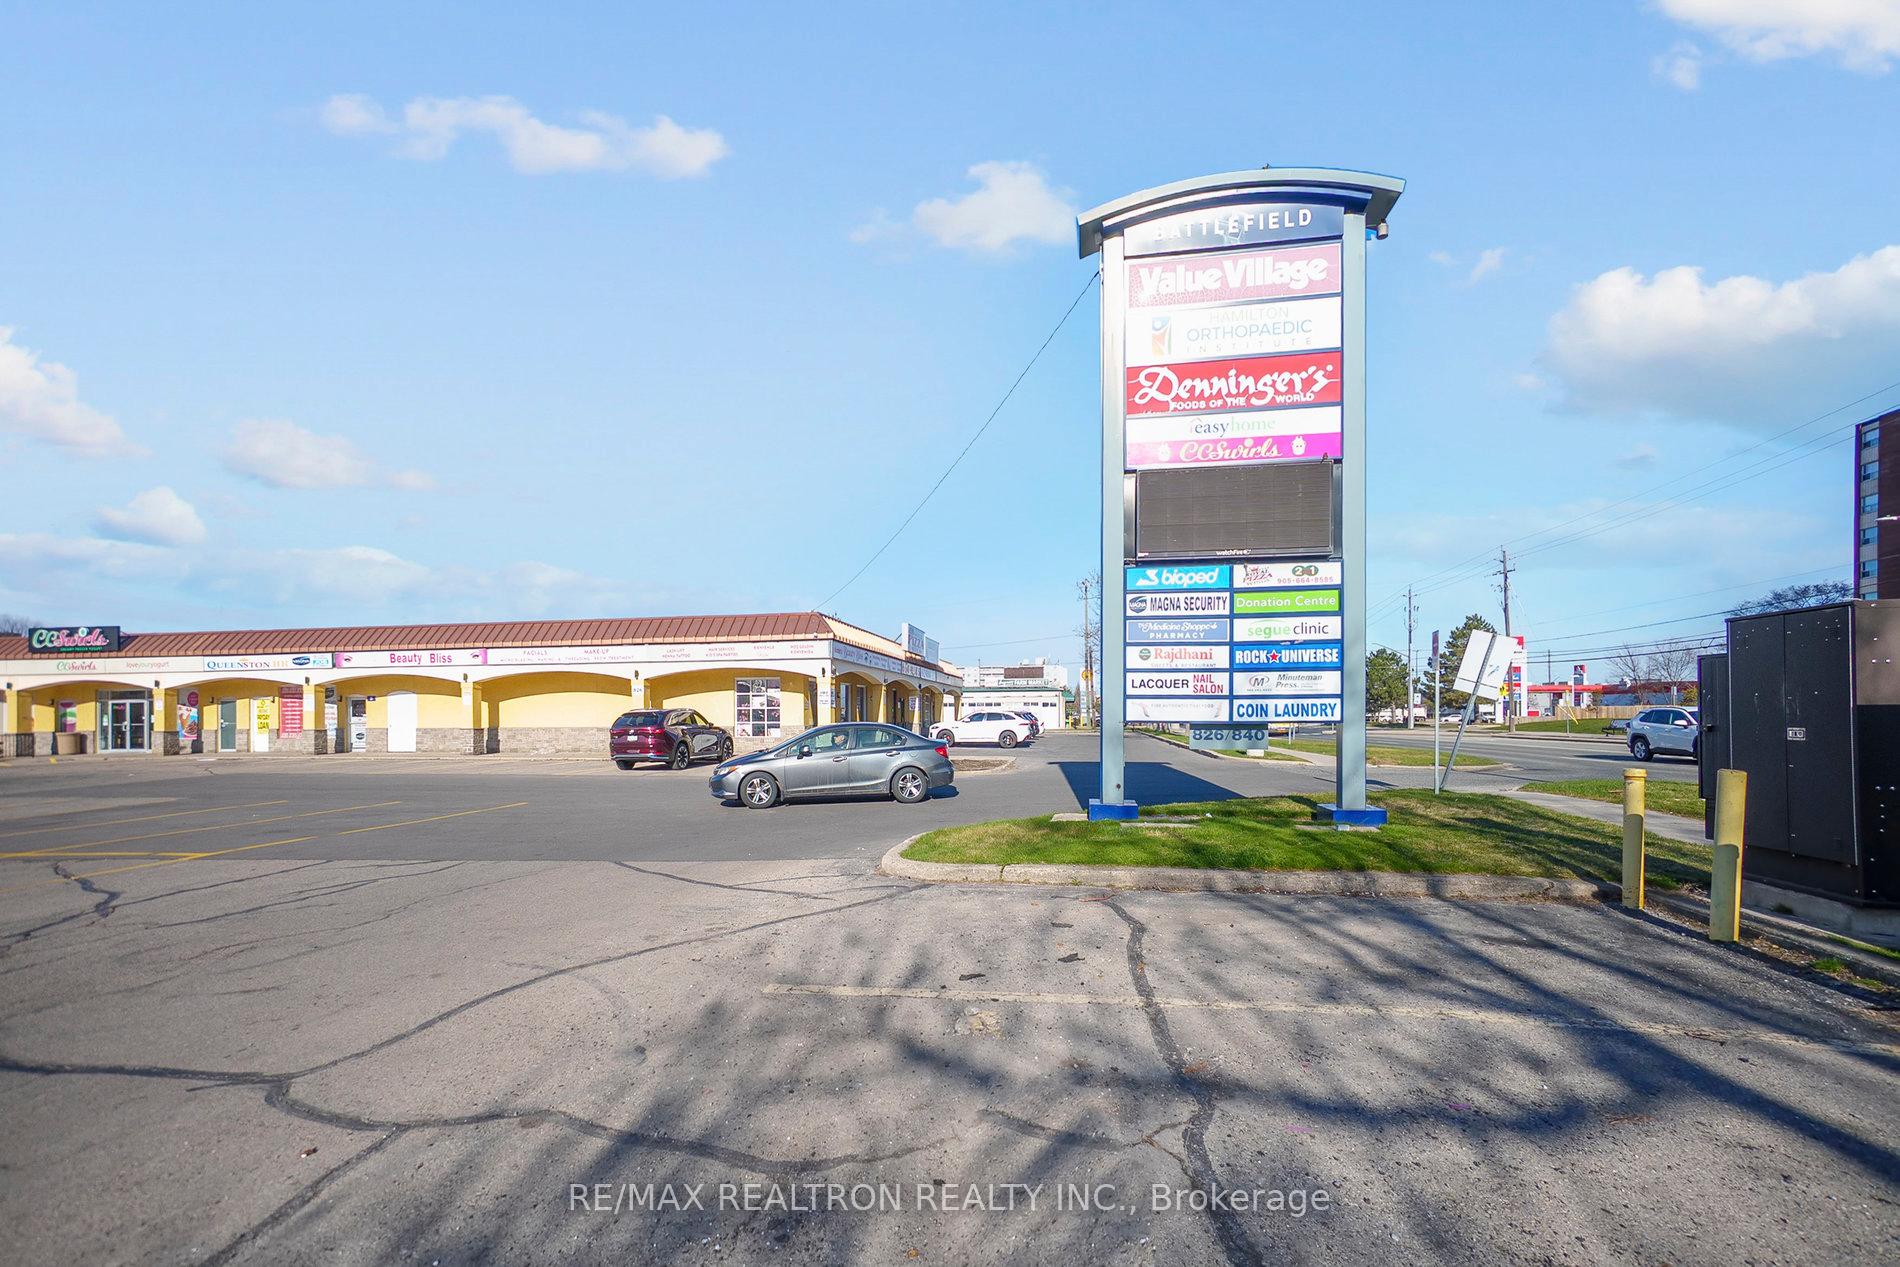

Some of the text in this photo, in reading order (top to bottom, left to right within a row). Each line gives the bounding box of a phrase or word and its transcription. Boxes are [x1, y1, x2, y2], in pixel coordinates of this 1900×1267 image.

[1154, 208, 1312, 241] BATTLEFIELD
[1138, 256, 1329, 295] Value Village
[1210, 306, 1289, 324] HAMILTON
[1186, 319, 1313, 342] ORTHOPAEDIC
[1132, 365, 1328, 407] Denninger's
[1170, 393, 1315, 411] FOODS OF THE WORLD
[1161, 567, 1219, 588] bioped
[1150, 596, 1228, 612] MAGNA SECURITY
[1236, 595, 1336, 608] Donation Centre
[390, 653, 453, 665] Beauty Bliss
[1154, 648, 1214, 662] Rajdhani
[1235, 648, 1339, 664] ROCK UNIVERSE
[1131, 674, 1215, 689] LACQUER NAIL
[1193, 684, 1224, 694] SALON
[1237, 702, 1337, 718] COIN LAUNDRY
[1193, 730, 1265, 741] 826/840
